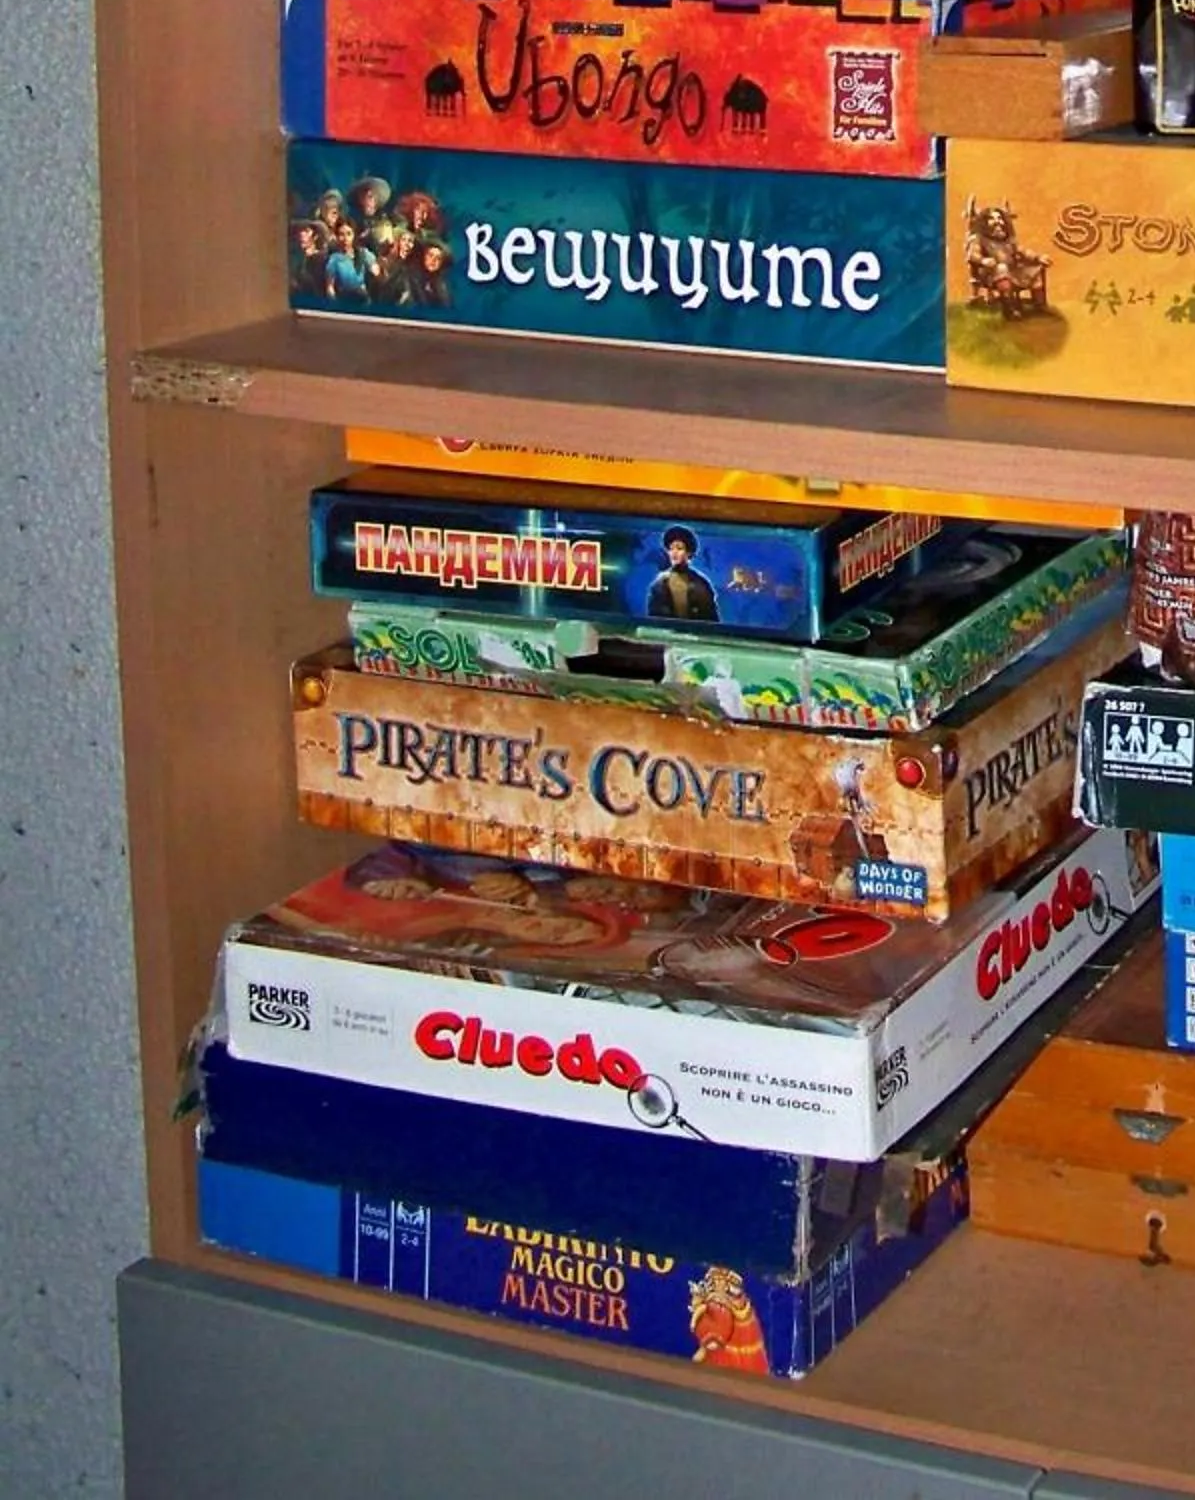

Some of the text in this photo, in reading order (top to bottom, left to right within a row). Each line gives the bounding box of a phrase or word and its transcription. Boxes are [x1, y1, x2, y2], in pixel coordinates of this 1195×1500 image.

[355, 521, 601, 591] ПАНДЕМИЯ
[334, 711, 771, 826] PIRATE'S COVE
[859, 863, 922, 883] DAYS OF
[975, 866, 1094, 1001] Cluedo
[247, 982, 310, 1007] PARKER
[413, 1010, 648, 1092] Cluedo
[679, 1061, 854, 1097] SCOPRIRE L'ASSASSINO
[700, 1085, 838, 1116] NON È UN GIOCO...
[363, 1203, 388, 1220] Anni
[400, 1232, 419, 1248] 2-4
[511, 1245, 625, 1295] MAGICO
[501, 1273, 630, 1332] MASTER
